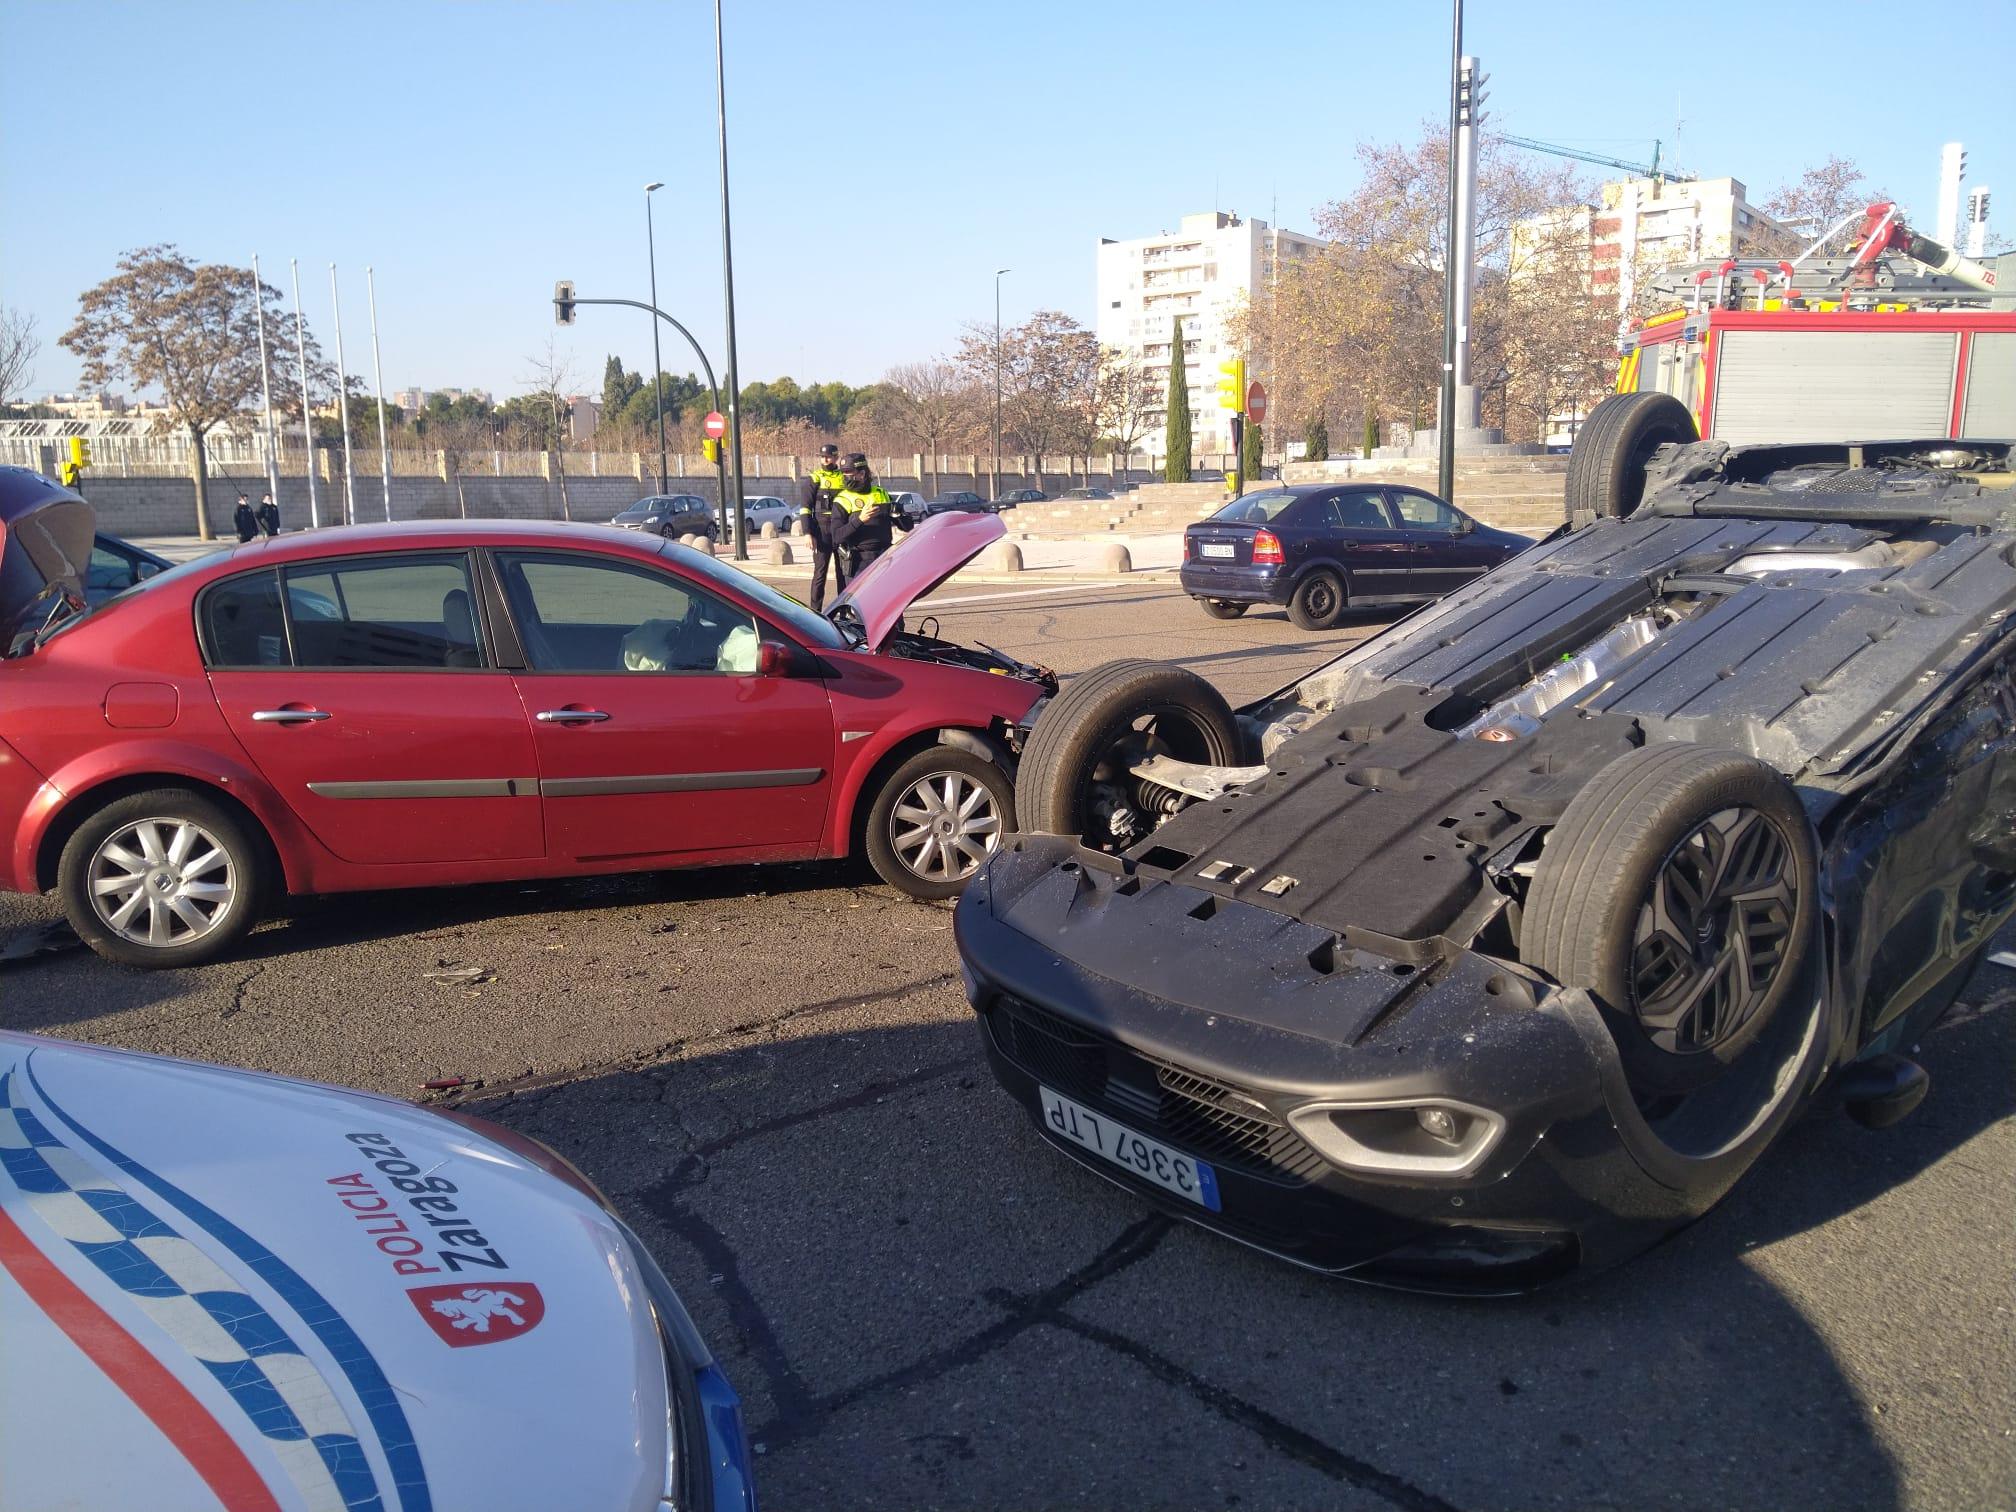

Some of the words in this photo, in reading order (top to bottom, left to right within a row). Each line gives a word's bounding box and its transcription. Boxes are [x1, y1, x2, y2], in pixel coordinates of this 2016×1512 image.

[1051, 1101, 1103, 1150] LTP
[1115, 1132, 1193, 1193] 3367
[326, 1172, 442, 1276] POLICIA
[345, 1133, 509, 1273] Zaragoza
